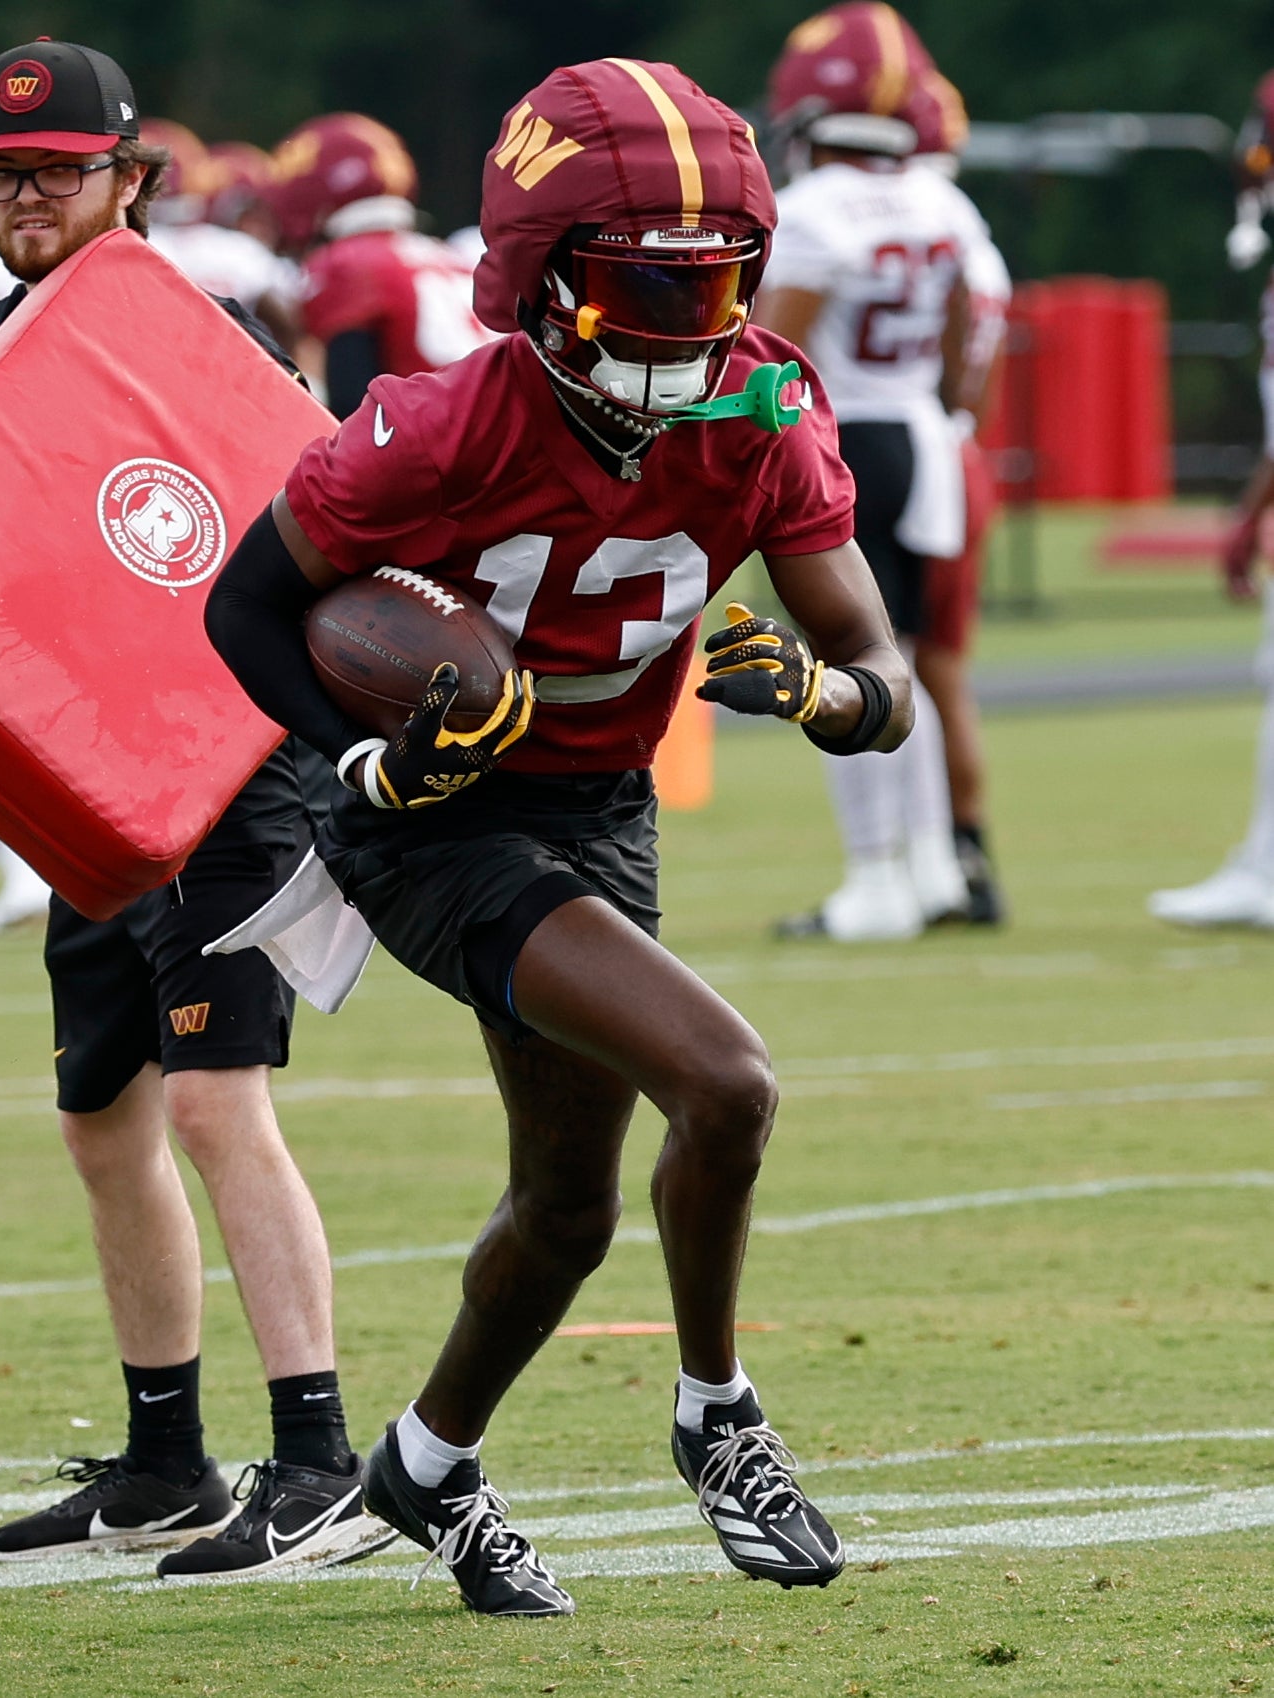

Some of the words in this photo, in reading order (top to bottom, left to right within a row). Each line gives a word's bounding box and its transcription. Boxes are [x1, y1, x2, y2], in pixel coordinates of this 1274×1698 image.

[109, 518, 169, 575] ROGERS
[110, 469, 151, 502] ROGERS
[153, 469, 209, 516] ATHLETIC
[185, 518, 215, 573] COMPANY
[124, 482, 193, 562] R
[345, 629, 387, 659] FOOTBALL
[474, 531, 709, 704] 13
